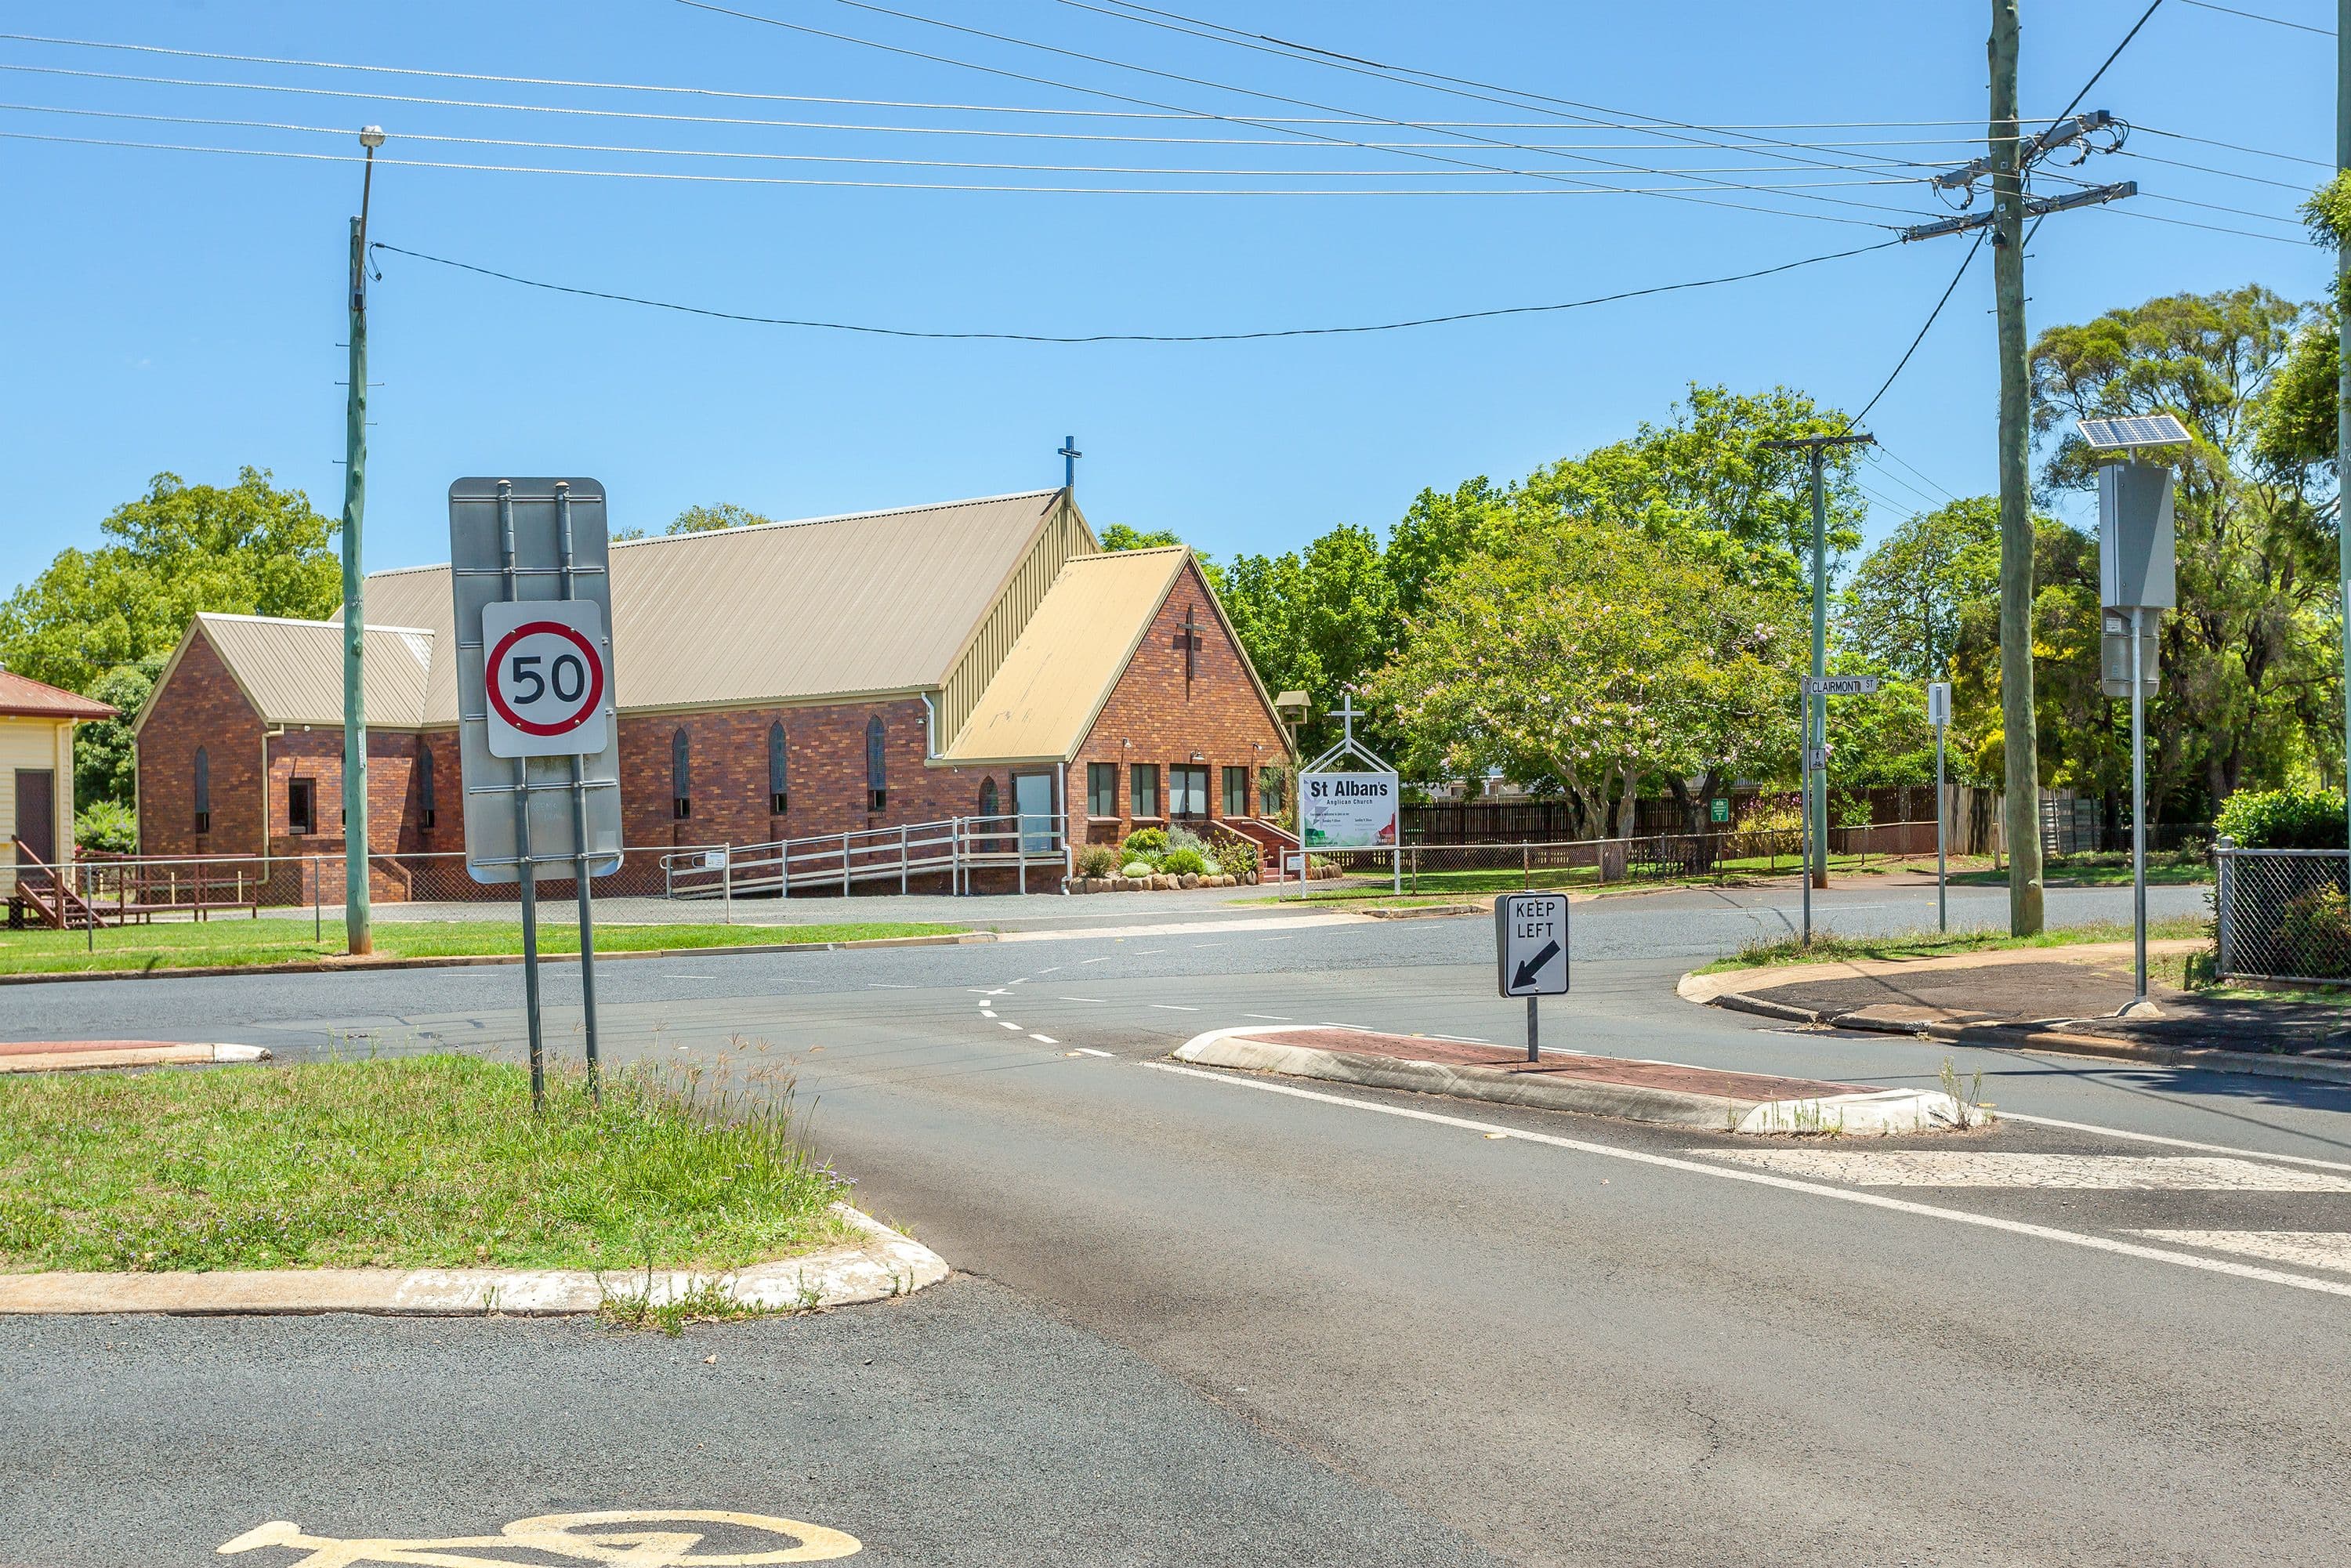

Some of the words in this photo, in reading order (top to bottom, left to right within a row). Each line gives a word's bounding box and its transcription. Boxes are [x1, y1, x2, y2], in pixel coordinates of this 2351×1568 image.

[513, 654, 585, 704] 50
[1866, 679, 1874, 688] ST
[1310, 780, 1328, 798] St
[1335, 780, 1388, 797] Alban's
[1516, 902, 1556, 918] KEEP
[1517, 922, 1554, 938] LEFT
